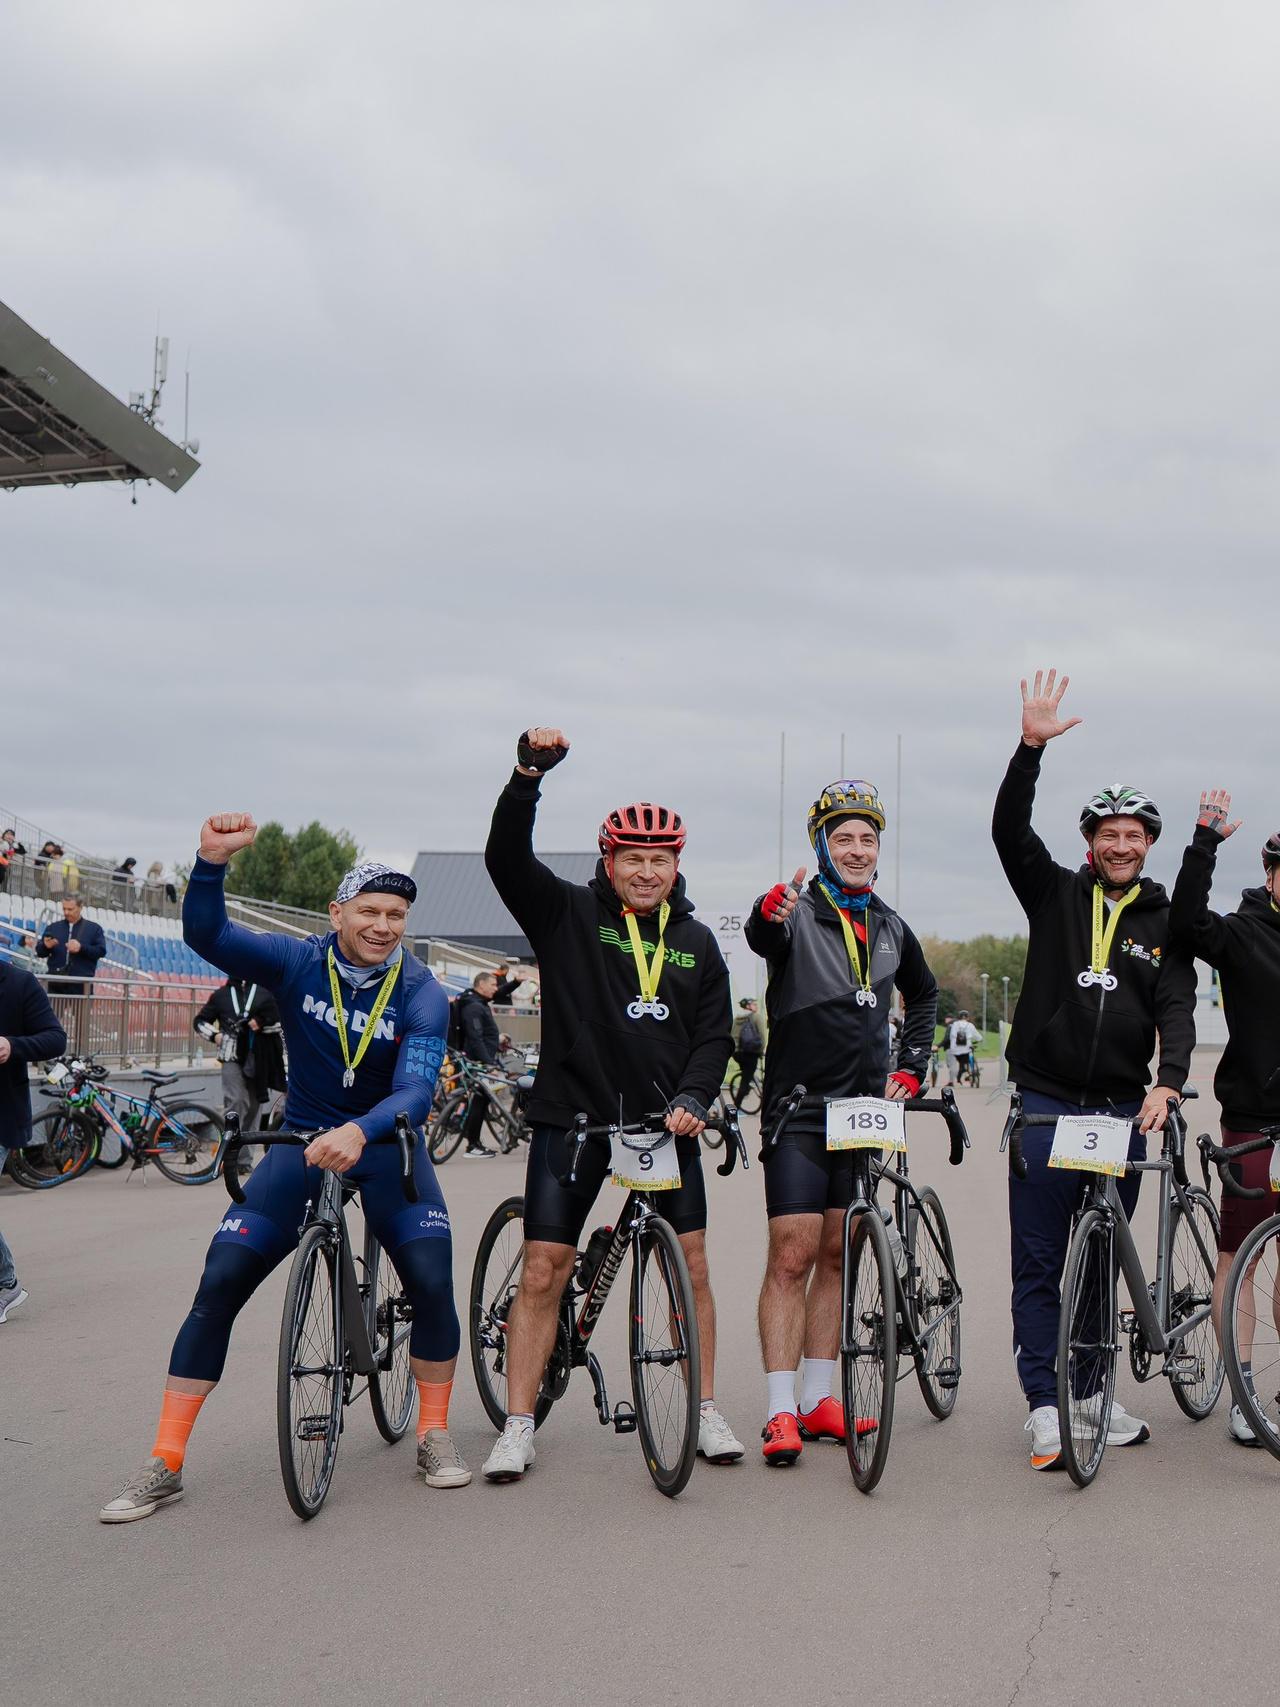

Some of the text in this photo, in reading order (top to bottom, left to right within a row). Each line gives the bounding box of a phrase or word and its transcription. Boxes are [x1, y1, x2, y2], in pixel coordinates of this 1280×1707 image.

[719, 916, 741, 930] 25
[1130, 943, 1144, 953] 25
[407, 1048, 443, 1067] MG
[847, 1112, 887, 1130] 189
[1083, 1132, 1099, 1150] 3
[638, 1151, 654, 1171] 9
